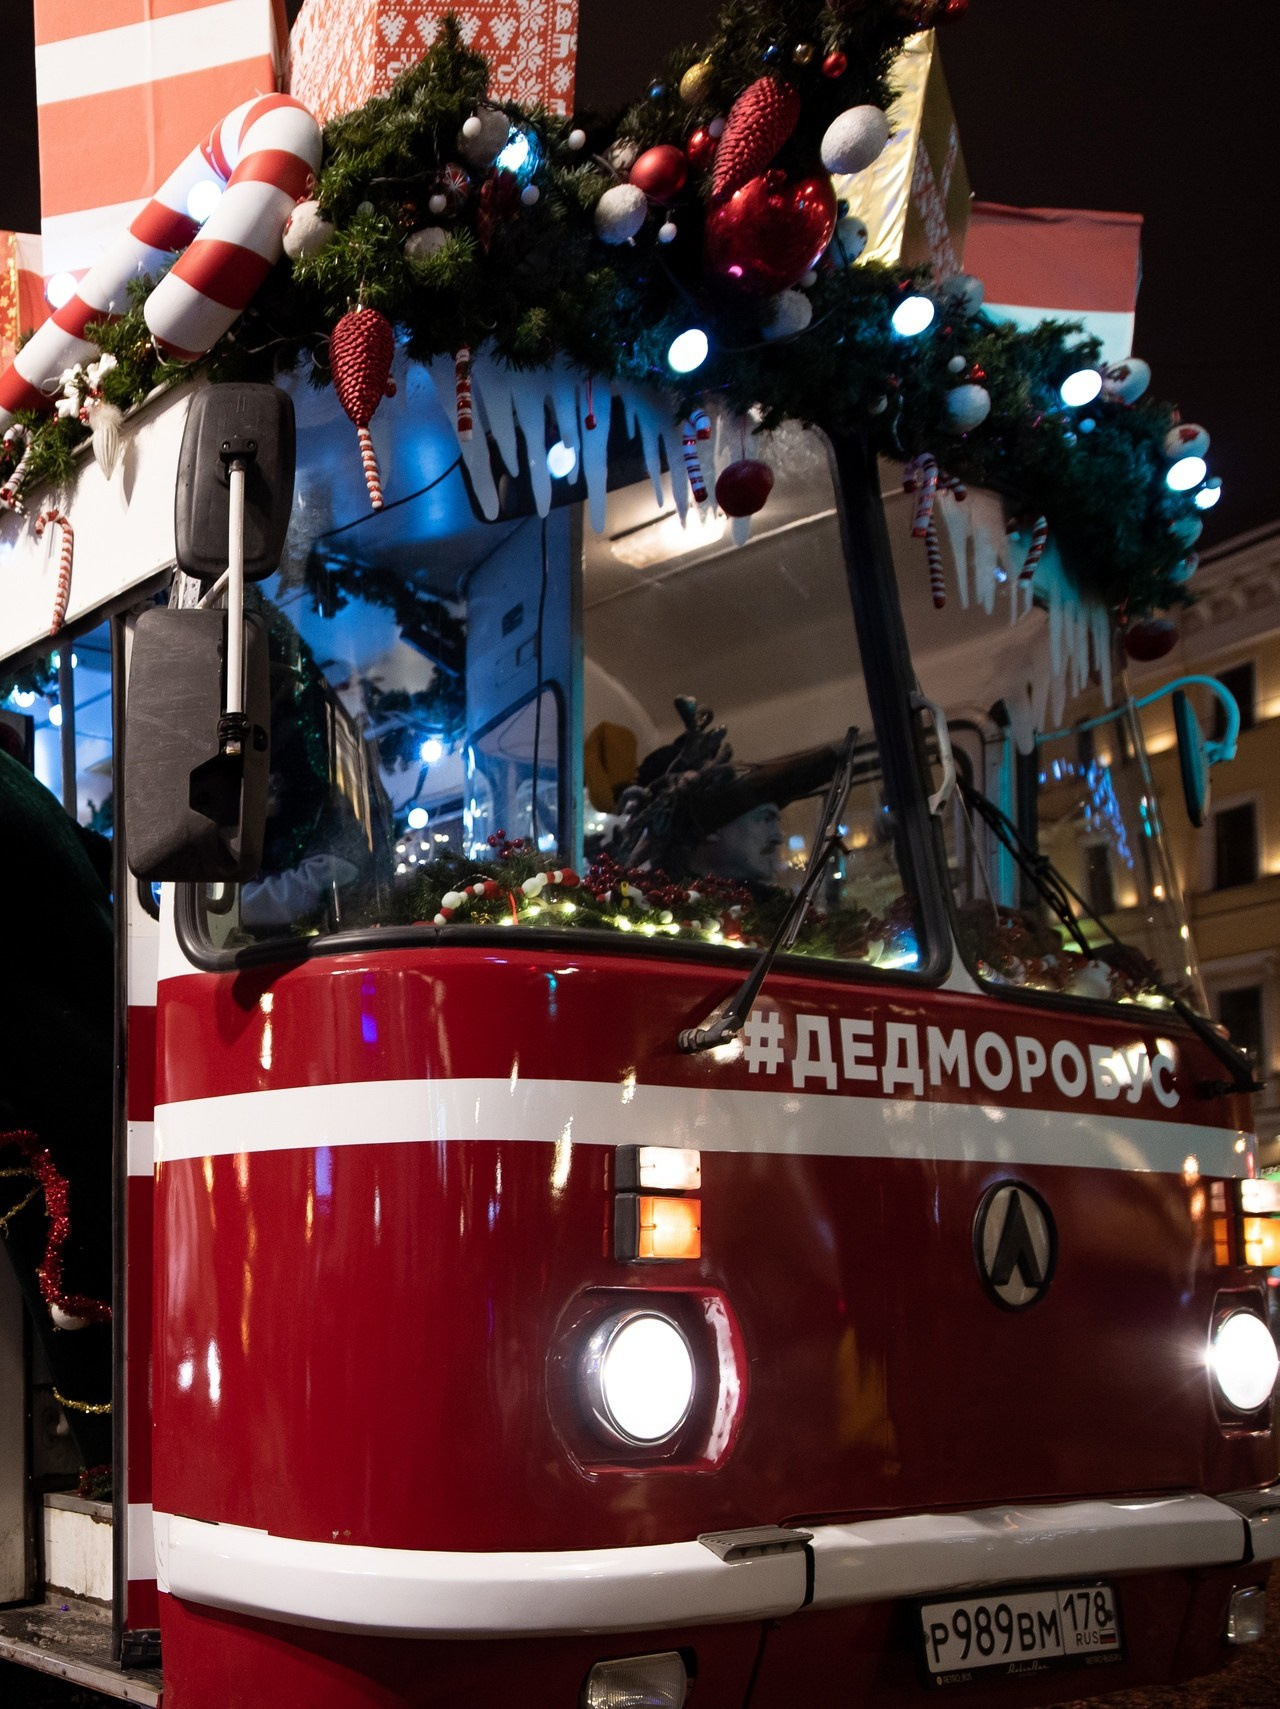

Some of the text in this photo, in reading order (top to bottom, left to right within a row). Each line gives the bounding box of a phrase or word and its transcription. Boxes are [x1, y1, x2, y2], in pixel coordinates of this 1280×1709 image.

[744, 1010, 1180, 1109] #ДЕДМОРОБУС
[1063, 1591, 1109, 1631] 178
[1075, 1630, 1099, 1646] RUS
